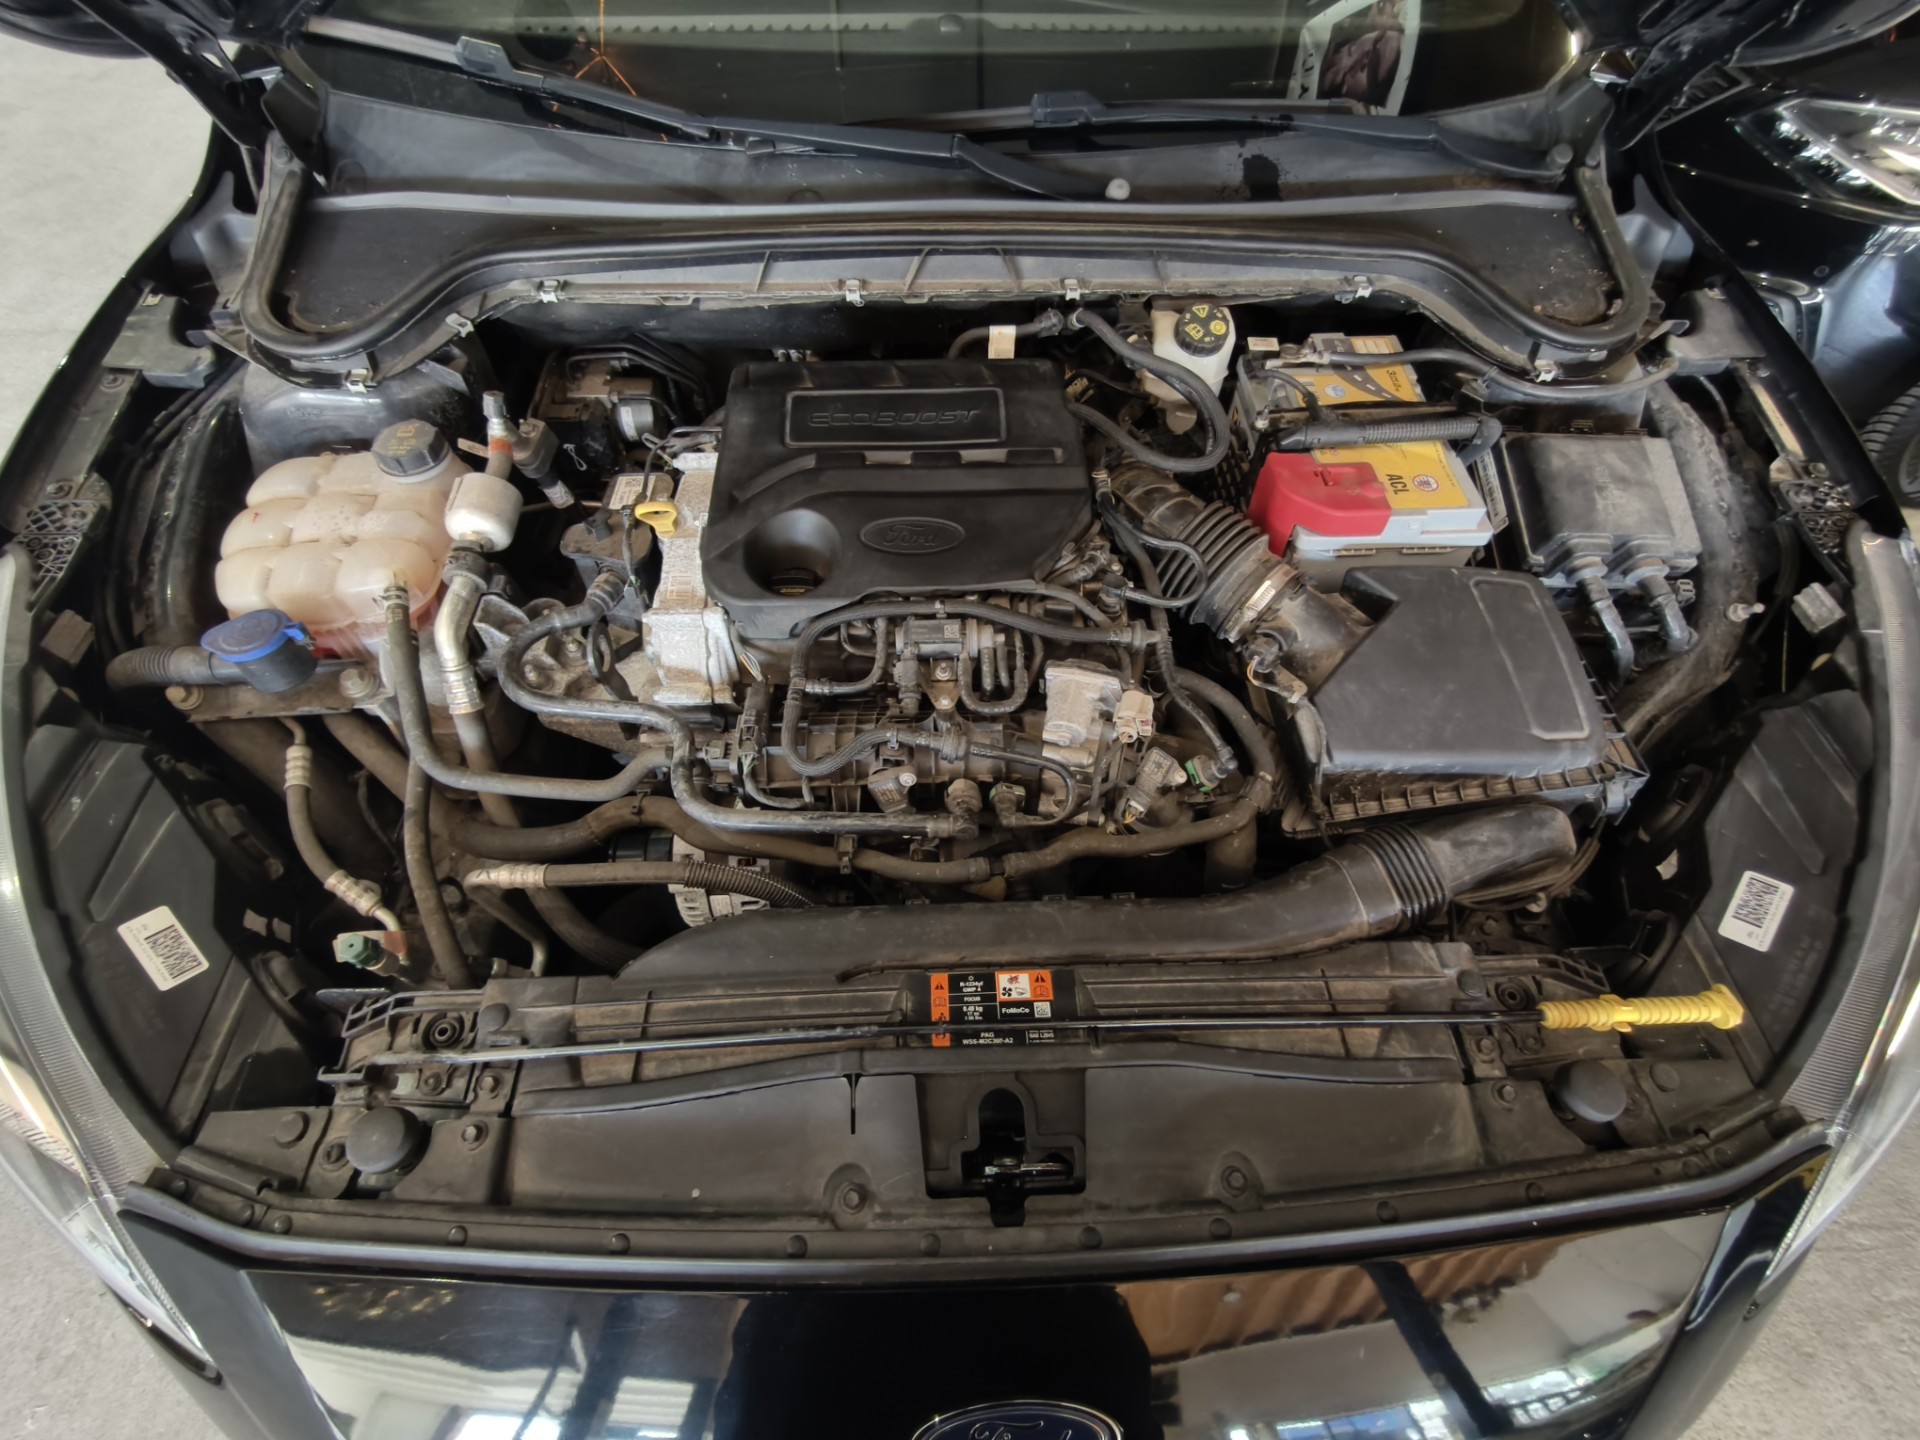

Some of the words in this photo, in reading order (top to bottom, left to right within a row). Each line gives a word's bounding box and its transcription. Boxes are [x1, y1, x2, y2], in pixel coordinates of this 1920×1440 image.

[808, 409, 981, 427] ECOBOOST
[1385, 473, 1404, 496] ACL
[883, 525, 938, 546] Ford
